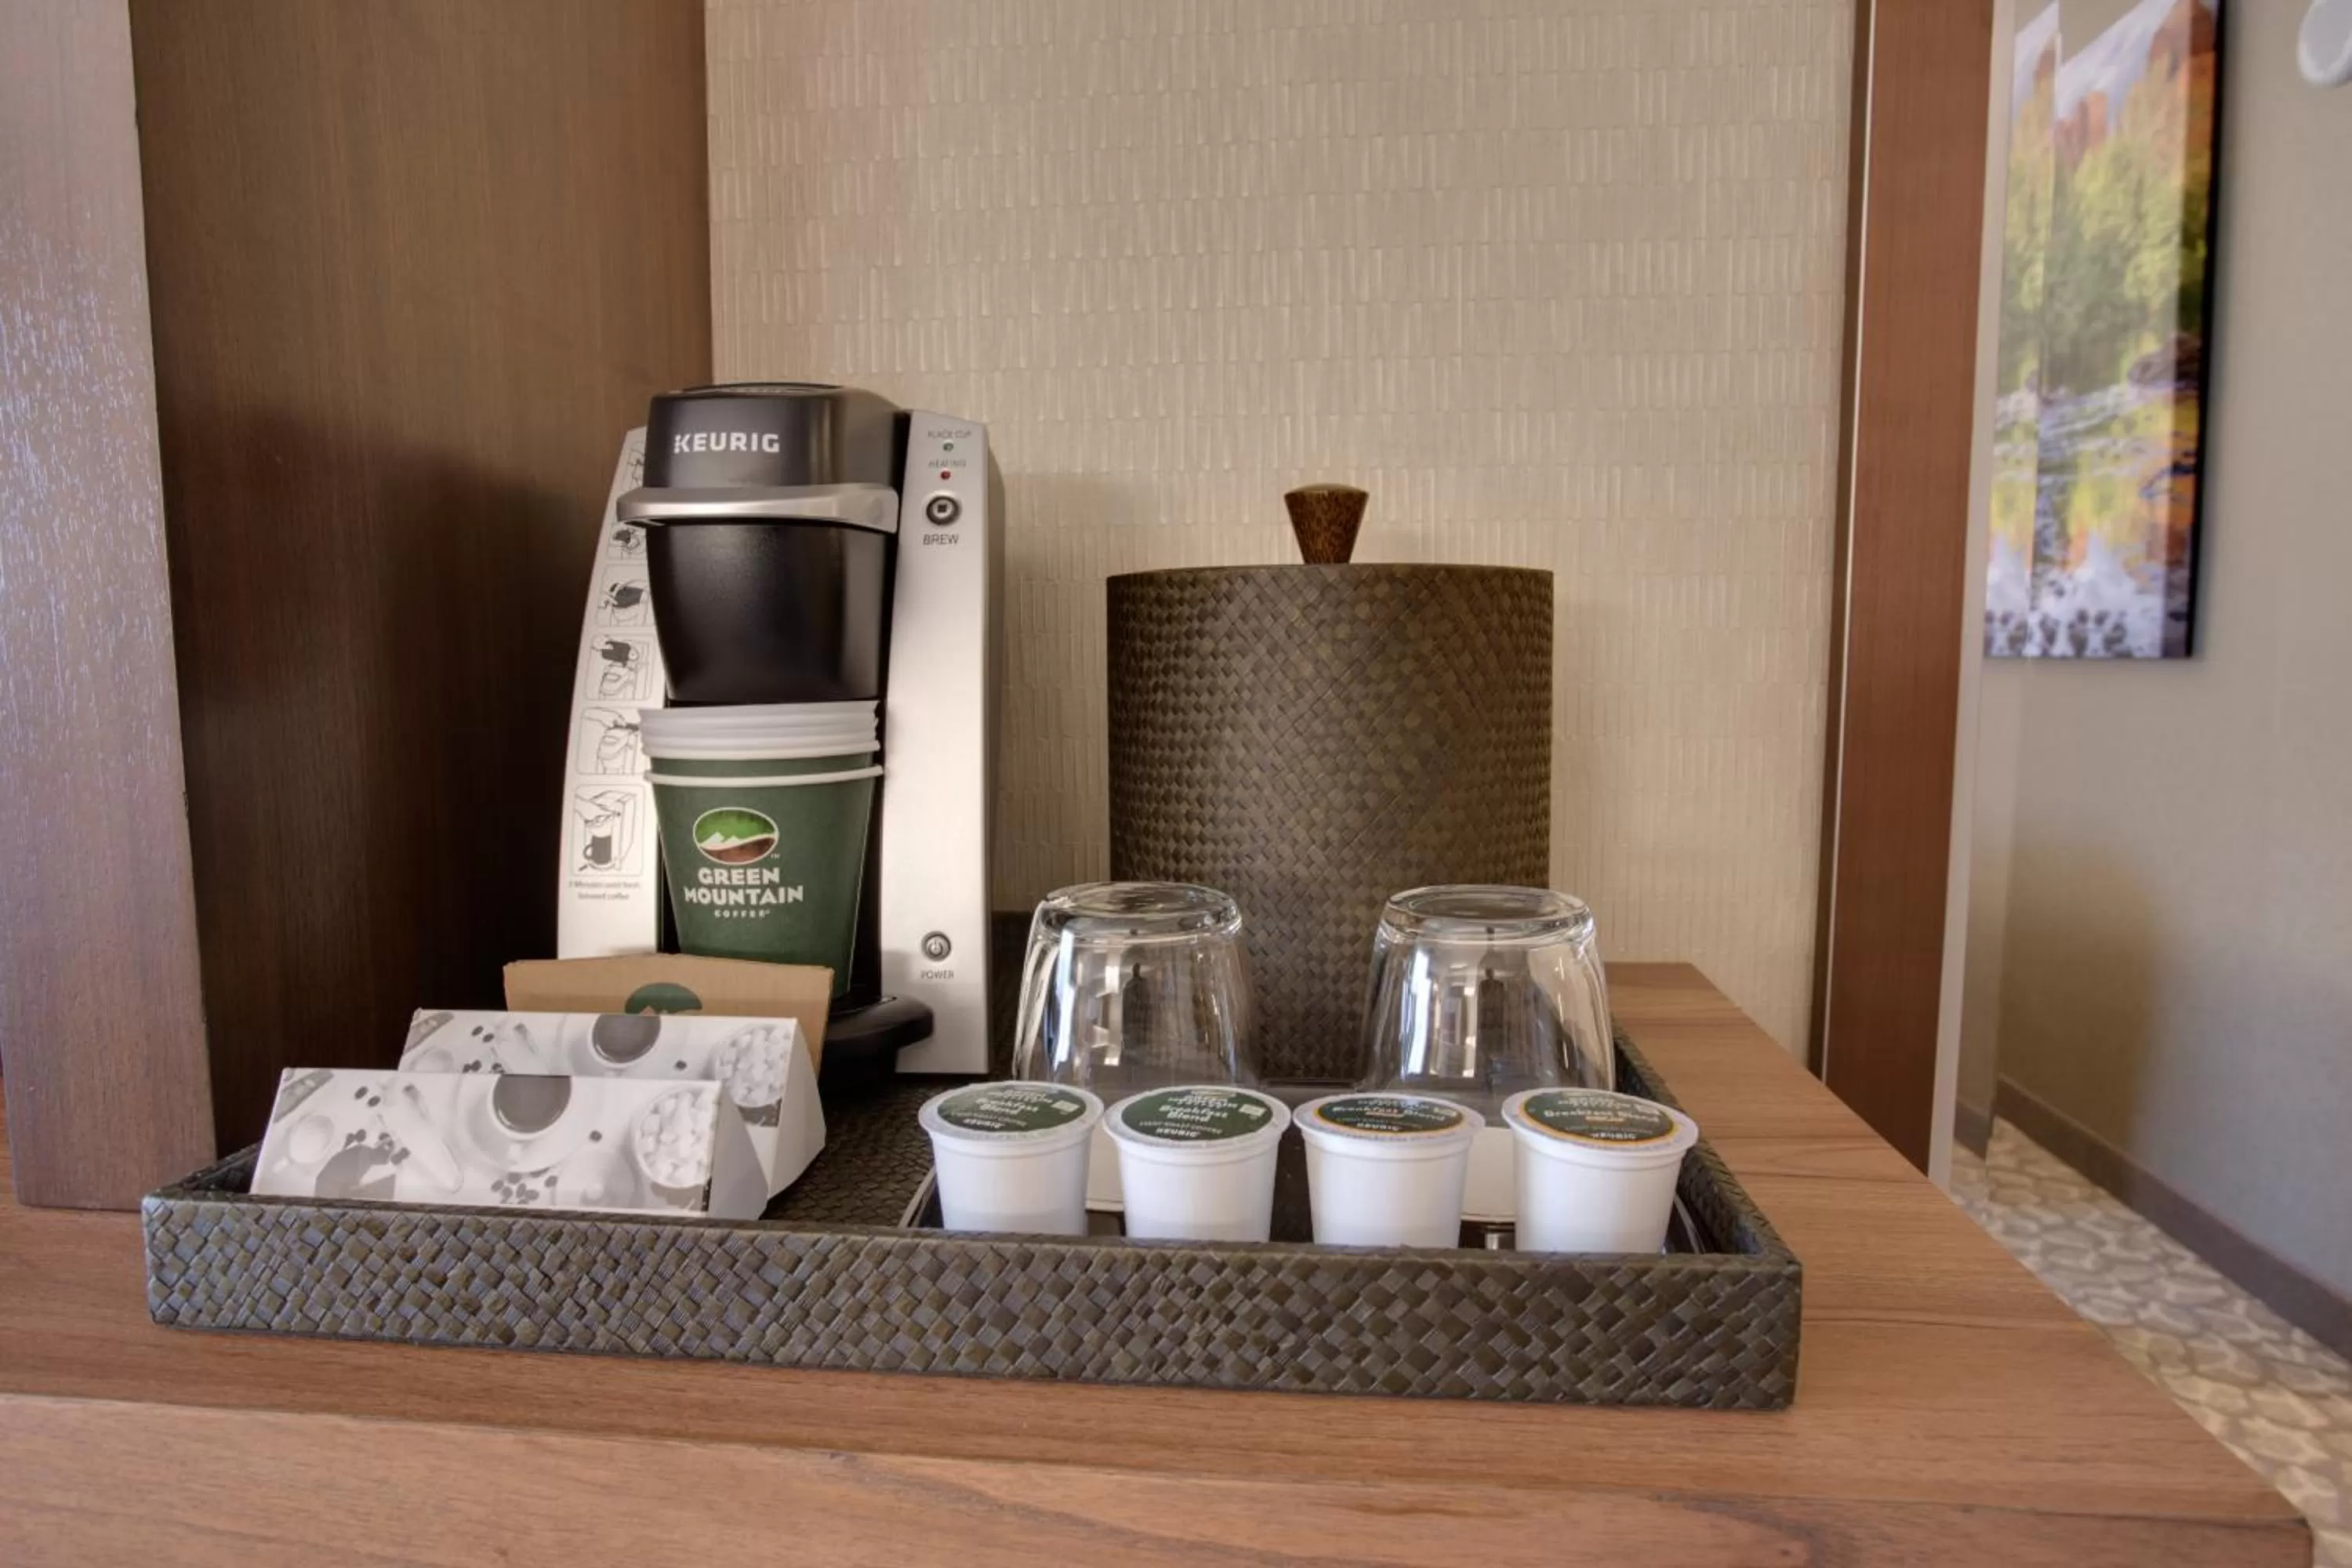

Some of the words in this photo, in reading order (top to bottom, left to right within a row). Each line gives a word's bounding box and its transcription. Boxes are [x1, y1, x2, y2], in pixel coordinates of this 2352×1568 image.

[673, 432, 780, 454] KEURIG
[923, 534, 958, 545] BREW
[698, 867, 780, 885] GREEN
[684, 885, 804, 906] MOUNTAIN
[920, 969, 954, 978] POWER
[1159, 1105, 1229, 1119] Breakfast
[1167, 1112, 1211, 1122] Blend
[1404, 1110, 1446, 1121] Blend
[1156, 1127, 1200, 1138] KEURIG
[1356, 1123, 1401, 1131] KEURIG
